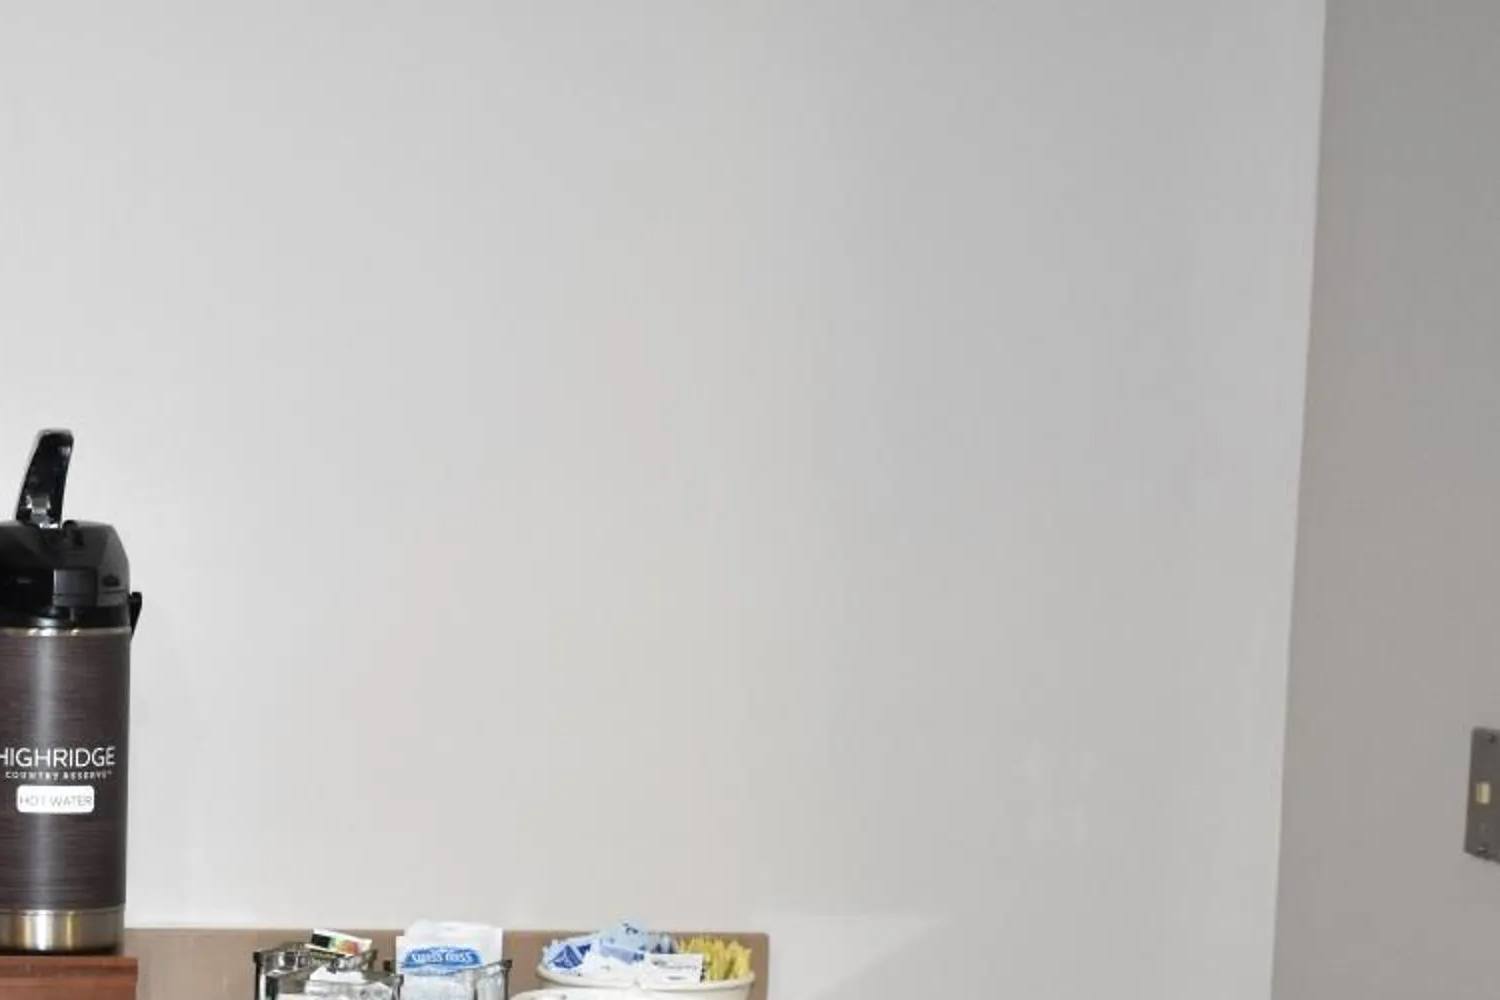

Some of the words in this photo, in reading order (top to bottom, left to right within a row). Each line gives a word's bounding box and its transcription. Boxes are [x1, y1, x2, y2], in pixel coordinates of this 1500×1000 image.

[5, 770, 59, 780] COUNTRY
[19, 795, 47, 807] HOT
[50, 795, 93, 807] WATER
